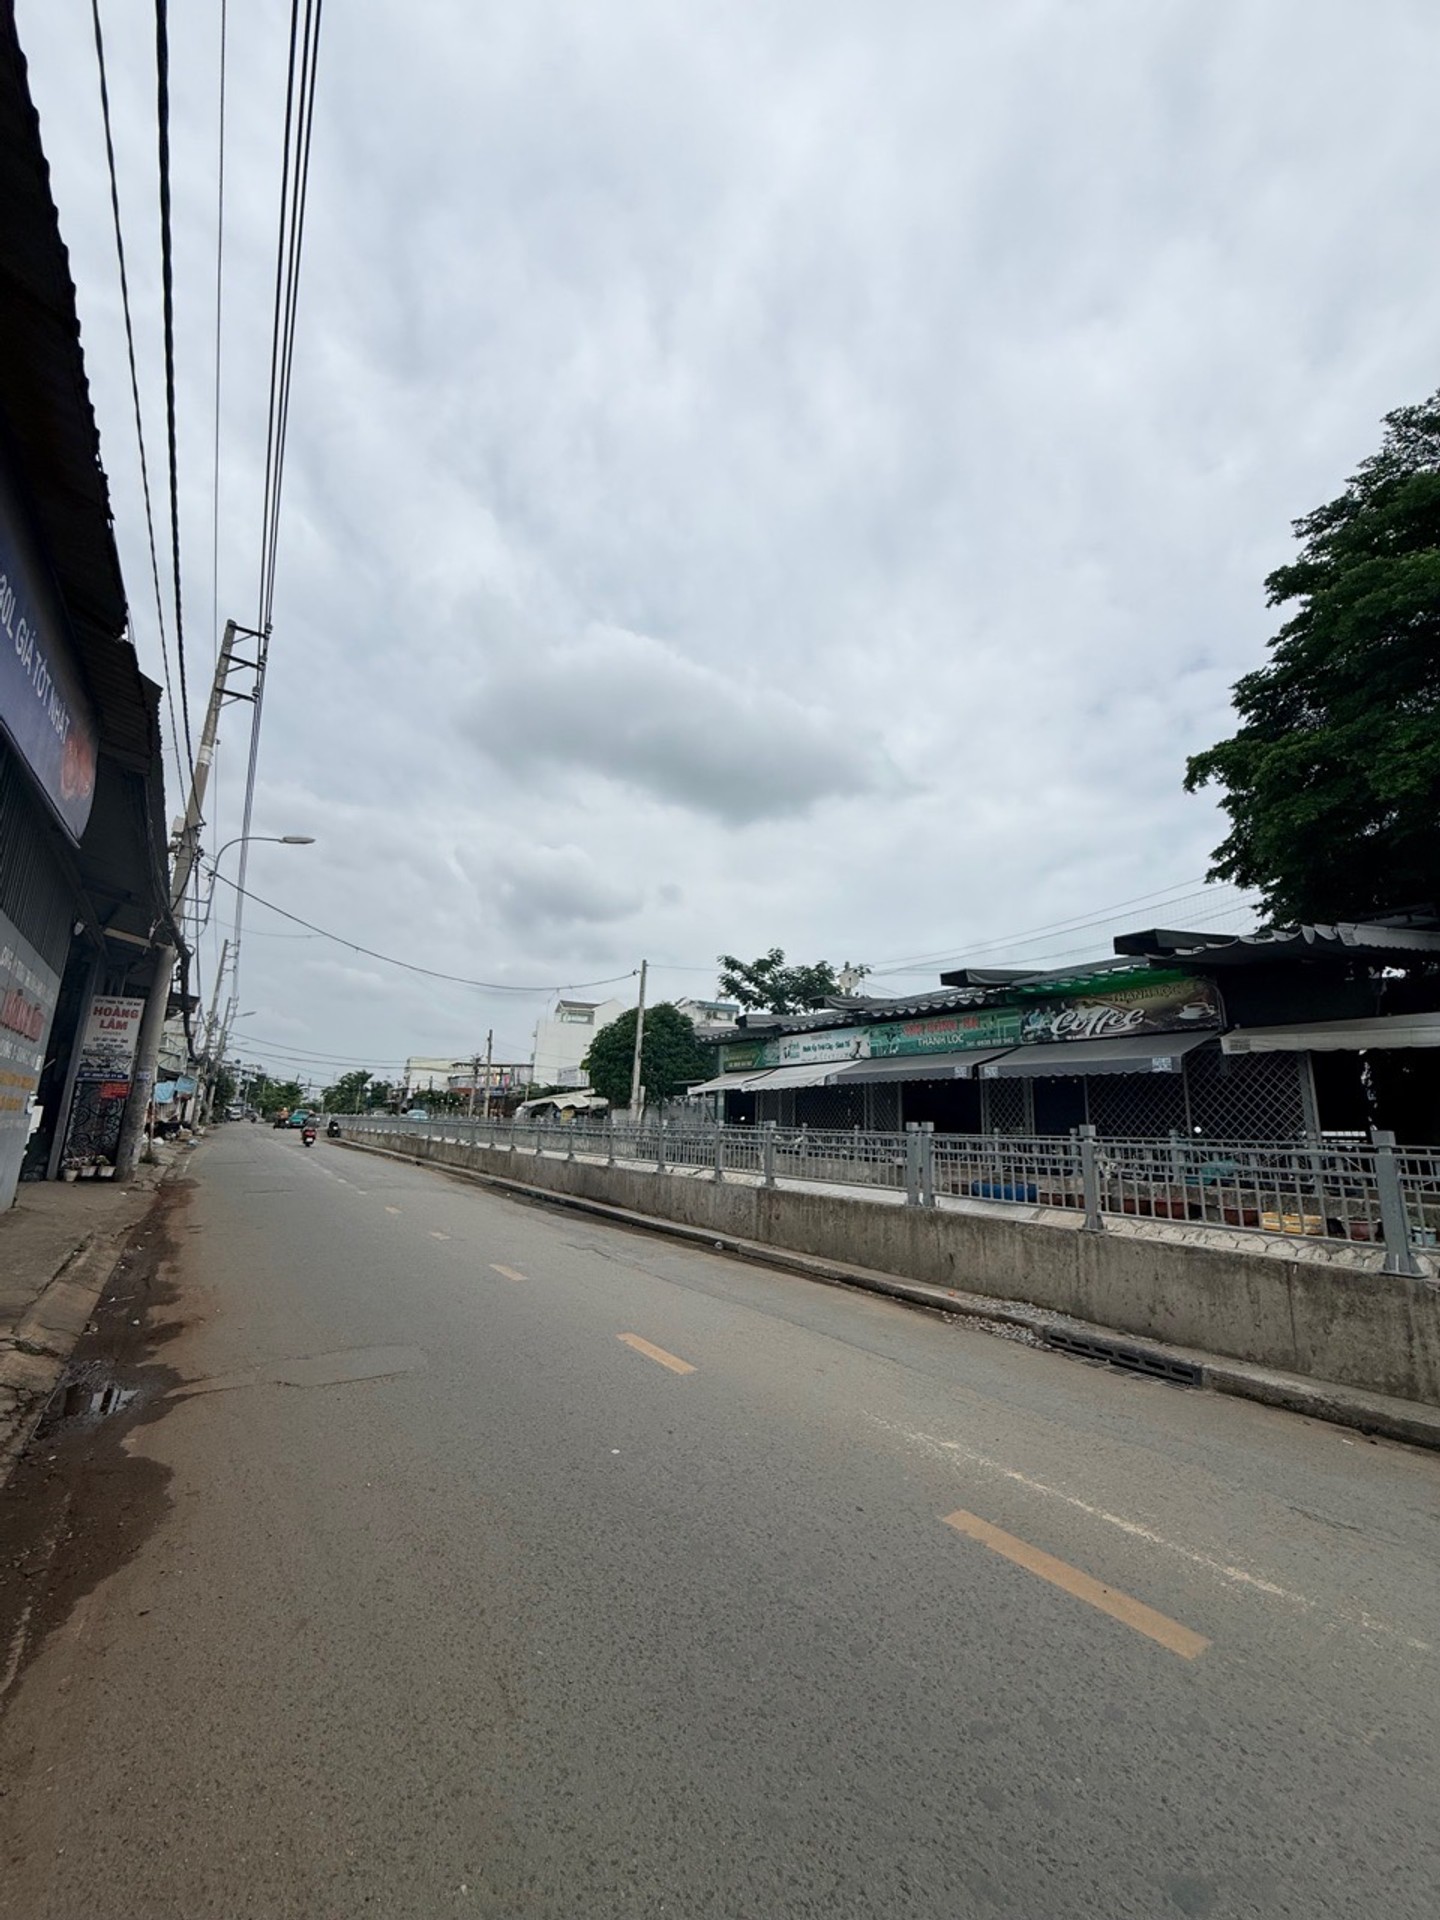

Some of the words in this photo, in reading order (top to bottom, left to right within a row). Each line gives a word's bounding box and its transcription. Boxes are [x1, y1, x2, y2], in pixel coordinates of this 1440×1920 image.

[15, 617, 36, 676] GIÁ
[93, 1005, 139, 1020] HOÀNG
[1051, 1008, 1146, 1036] Coffee
[917, 1034, 946, 1046] THANH
